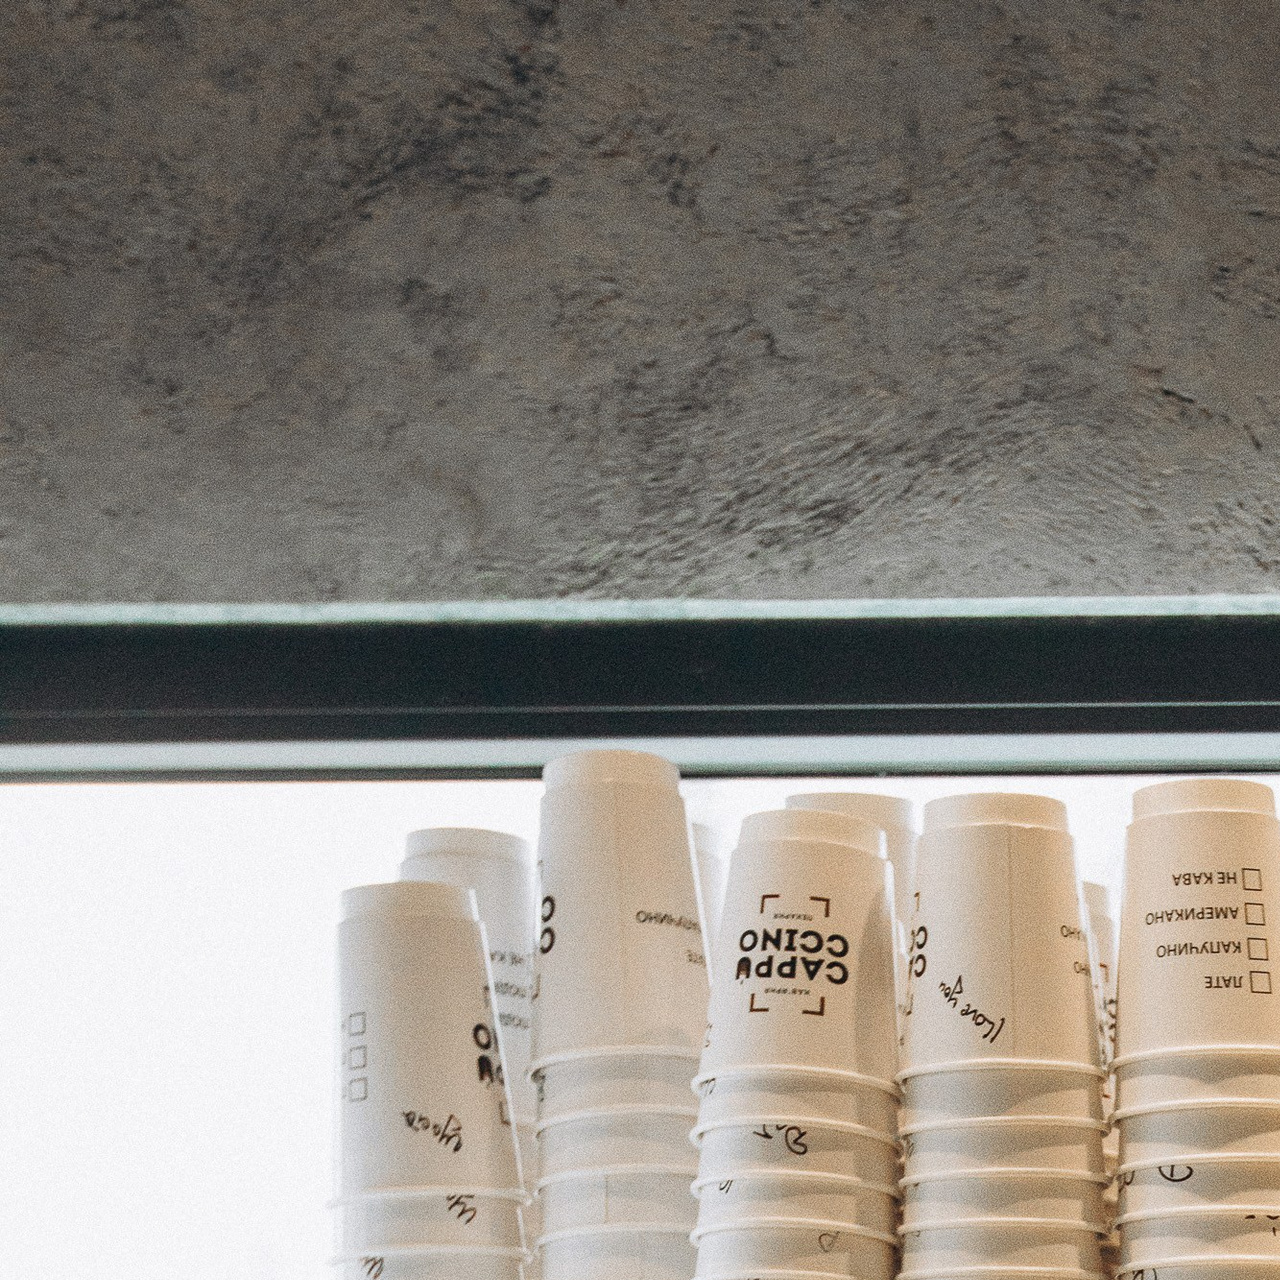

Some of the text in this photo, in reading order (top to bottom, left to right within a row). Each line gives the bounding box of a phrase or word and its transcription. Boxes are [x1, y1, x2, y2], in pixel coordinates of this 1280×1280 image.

[1172, 871, 1237, 887] НЕ КАВА
[1145, 906, 1239, 926] АМЕРИКАНО
[739, 928, 850, 958] CCINO
[1156, 941, 1242, 958] КАПУЧИНО
[1204, 975, 1243, 989] ЛАТЕ
